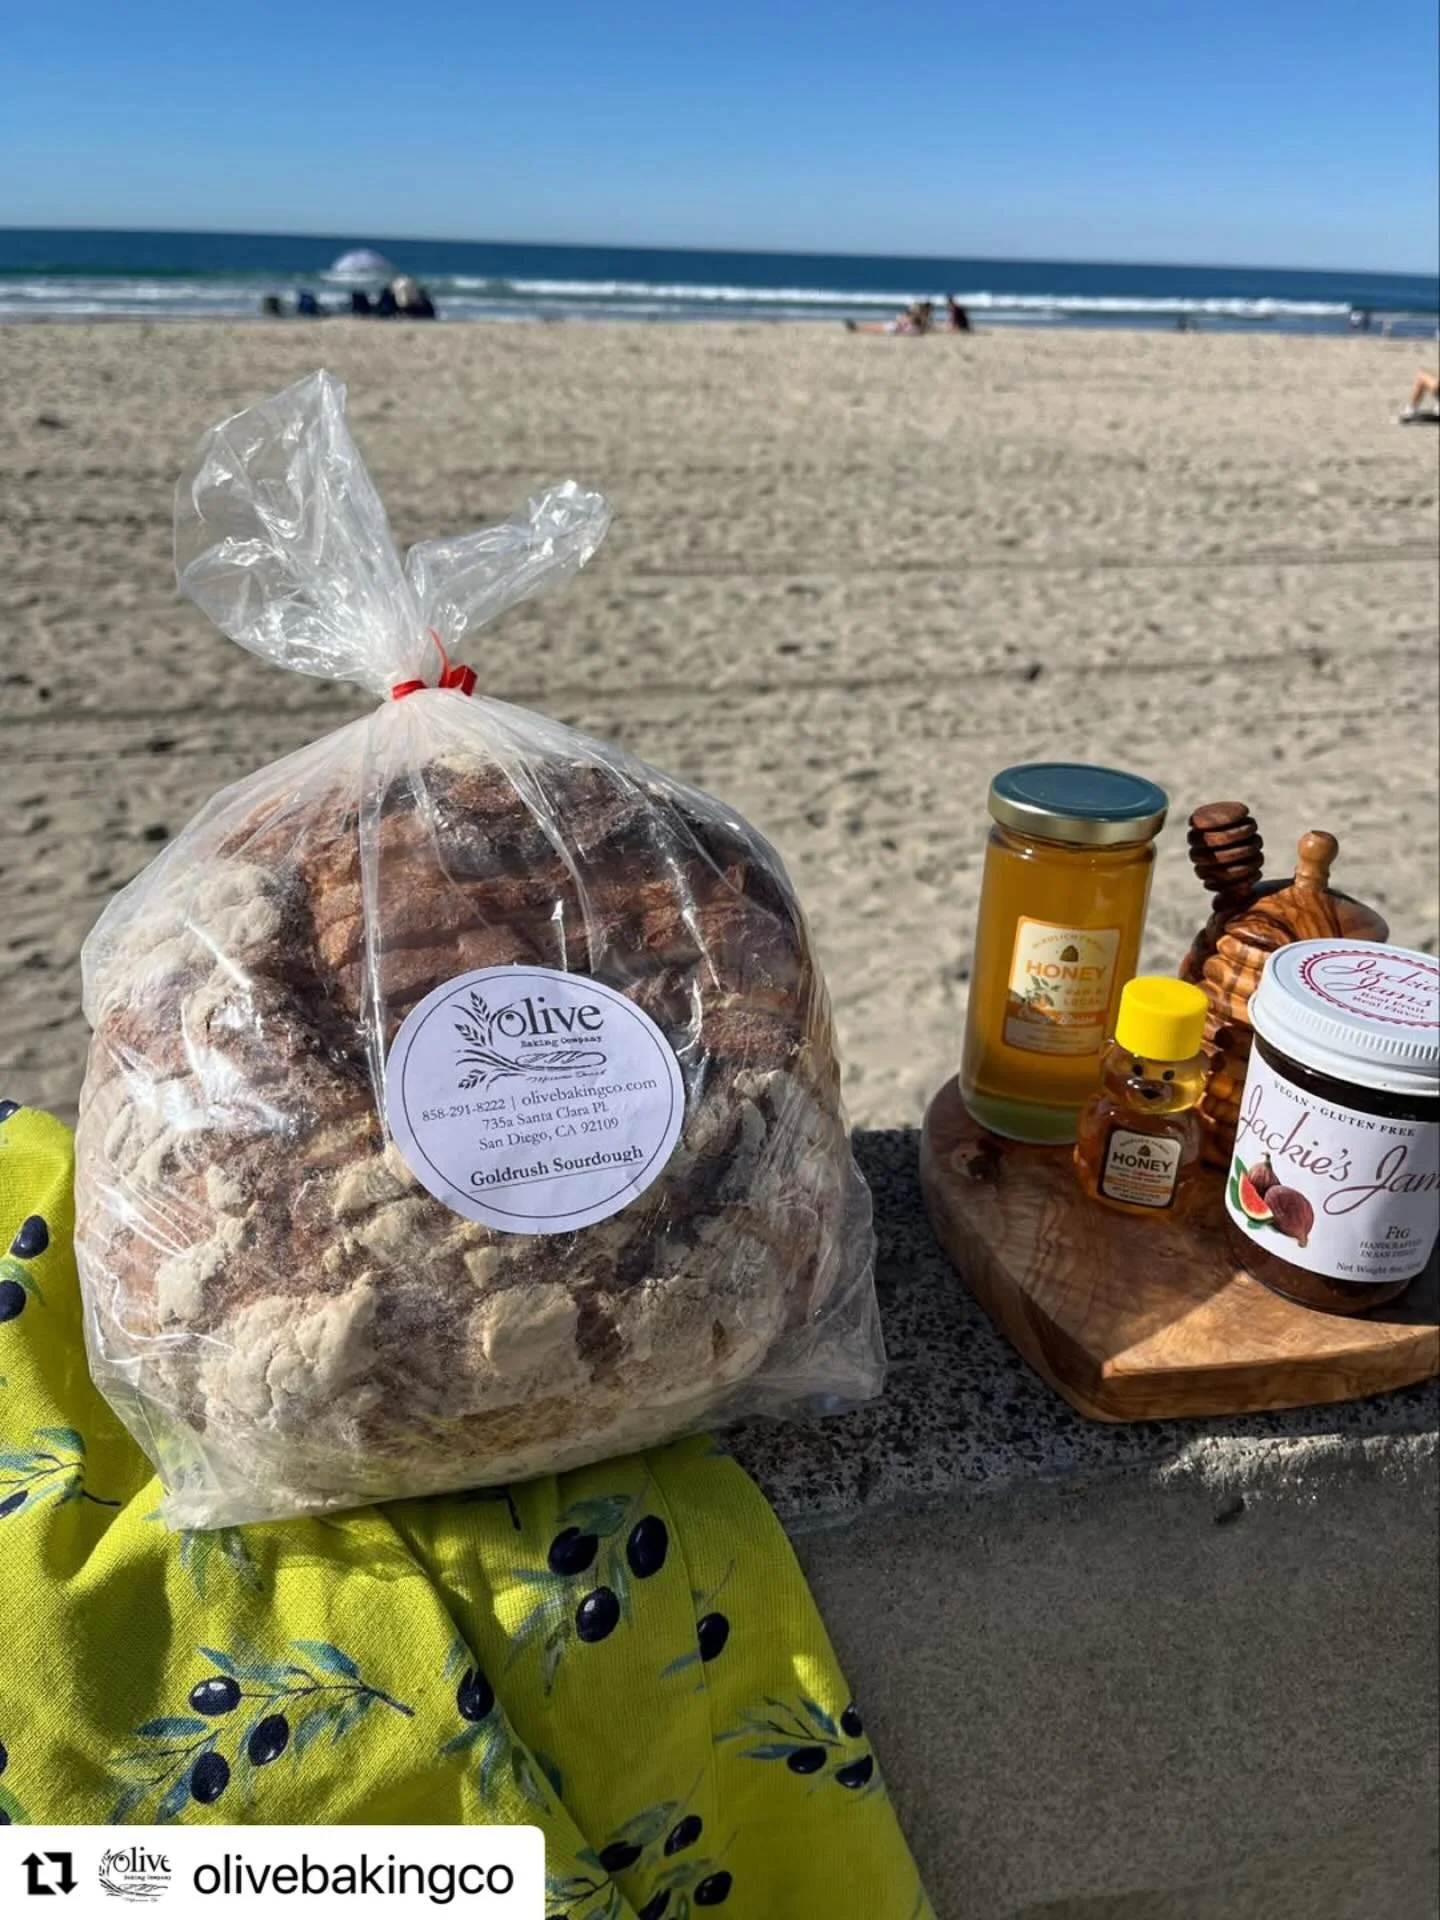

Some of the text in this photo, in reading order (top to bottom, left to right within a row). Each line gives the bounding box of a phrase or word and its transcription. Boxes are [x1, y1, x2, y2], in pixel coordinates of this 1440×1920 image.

[1025, 960, 1108, 980] HONEY
[1323, 976, 1431, 1007] Jams
[421, 1098, 506, 1122] 858-291-8222
[520, 1078, 658, 1107] olivebakingco.com
[1273, 1079, 1417, 1138] VEGAN GLUTEN FREE
[479, 1117, 620, 1151] San Diego, CA 92109
[481, 1117, 514, 1131] 735a
[516, 1111, 553, 1127] Santa
[555, 1104, 590, 1120] Clara
[1235, 1084, 1353, 1182] Jackie's
[470, 1145, 645, 1188] Goldrush Sourdough
[1112, 1151, 1173, 1173] HONEY
